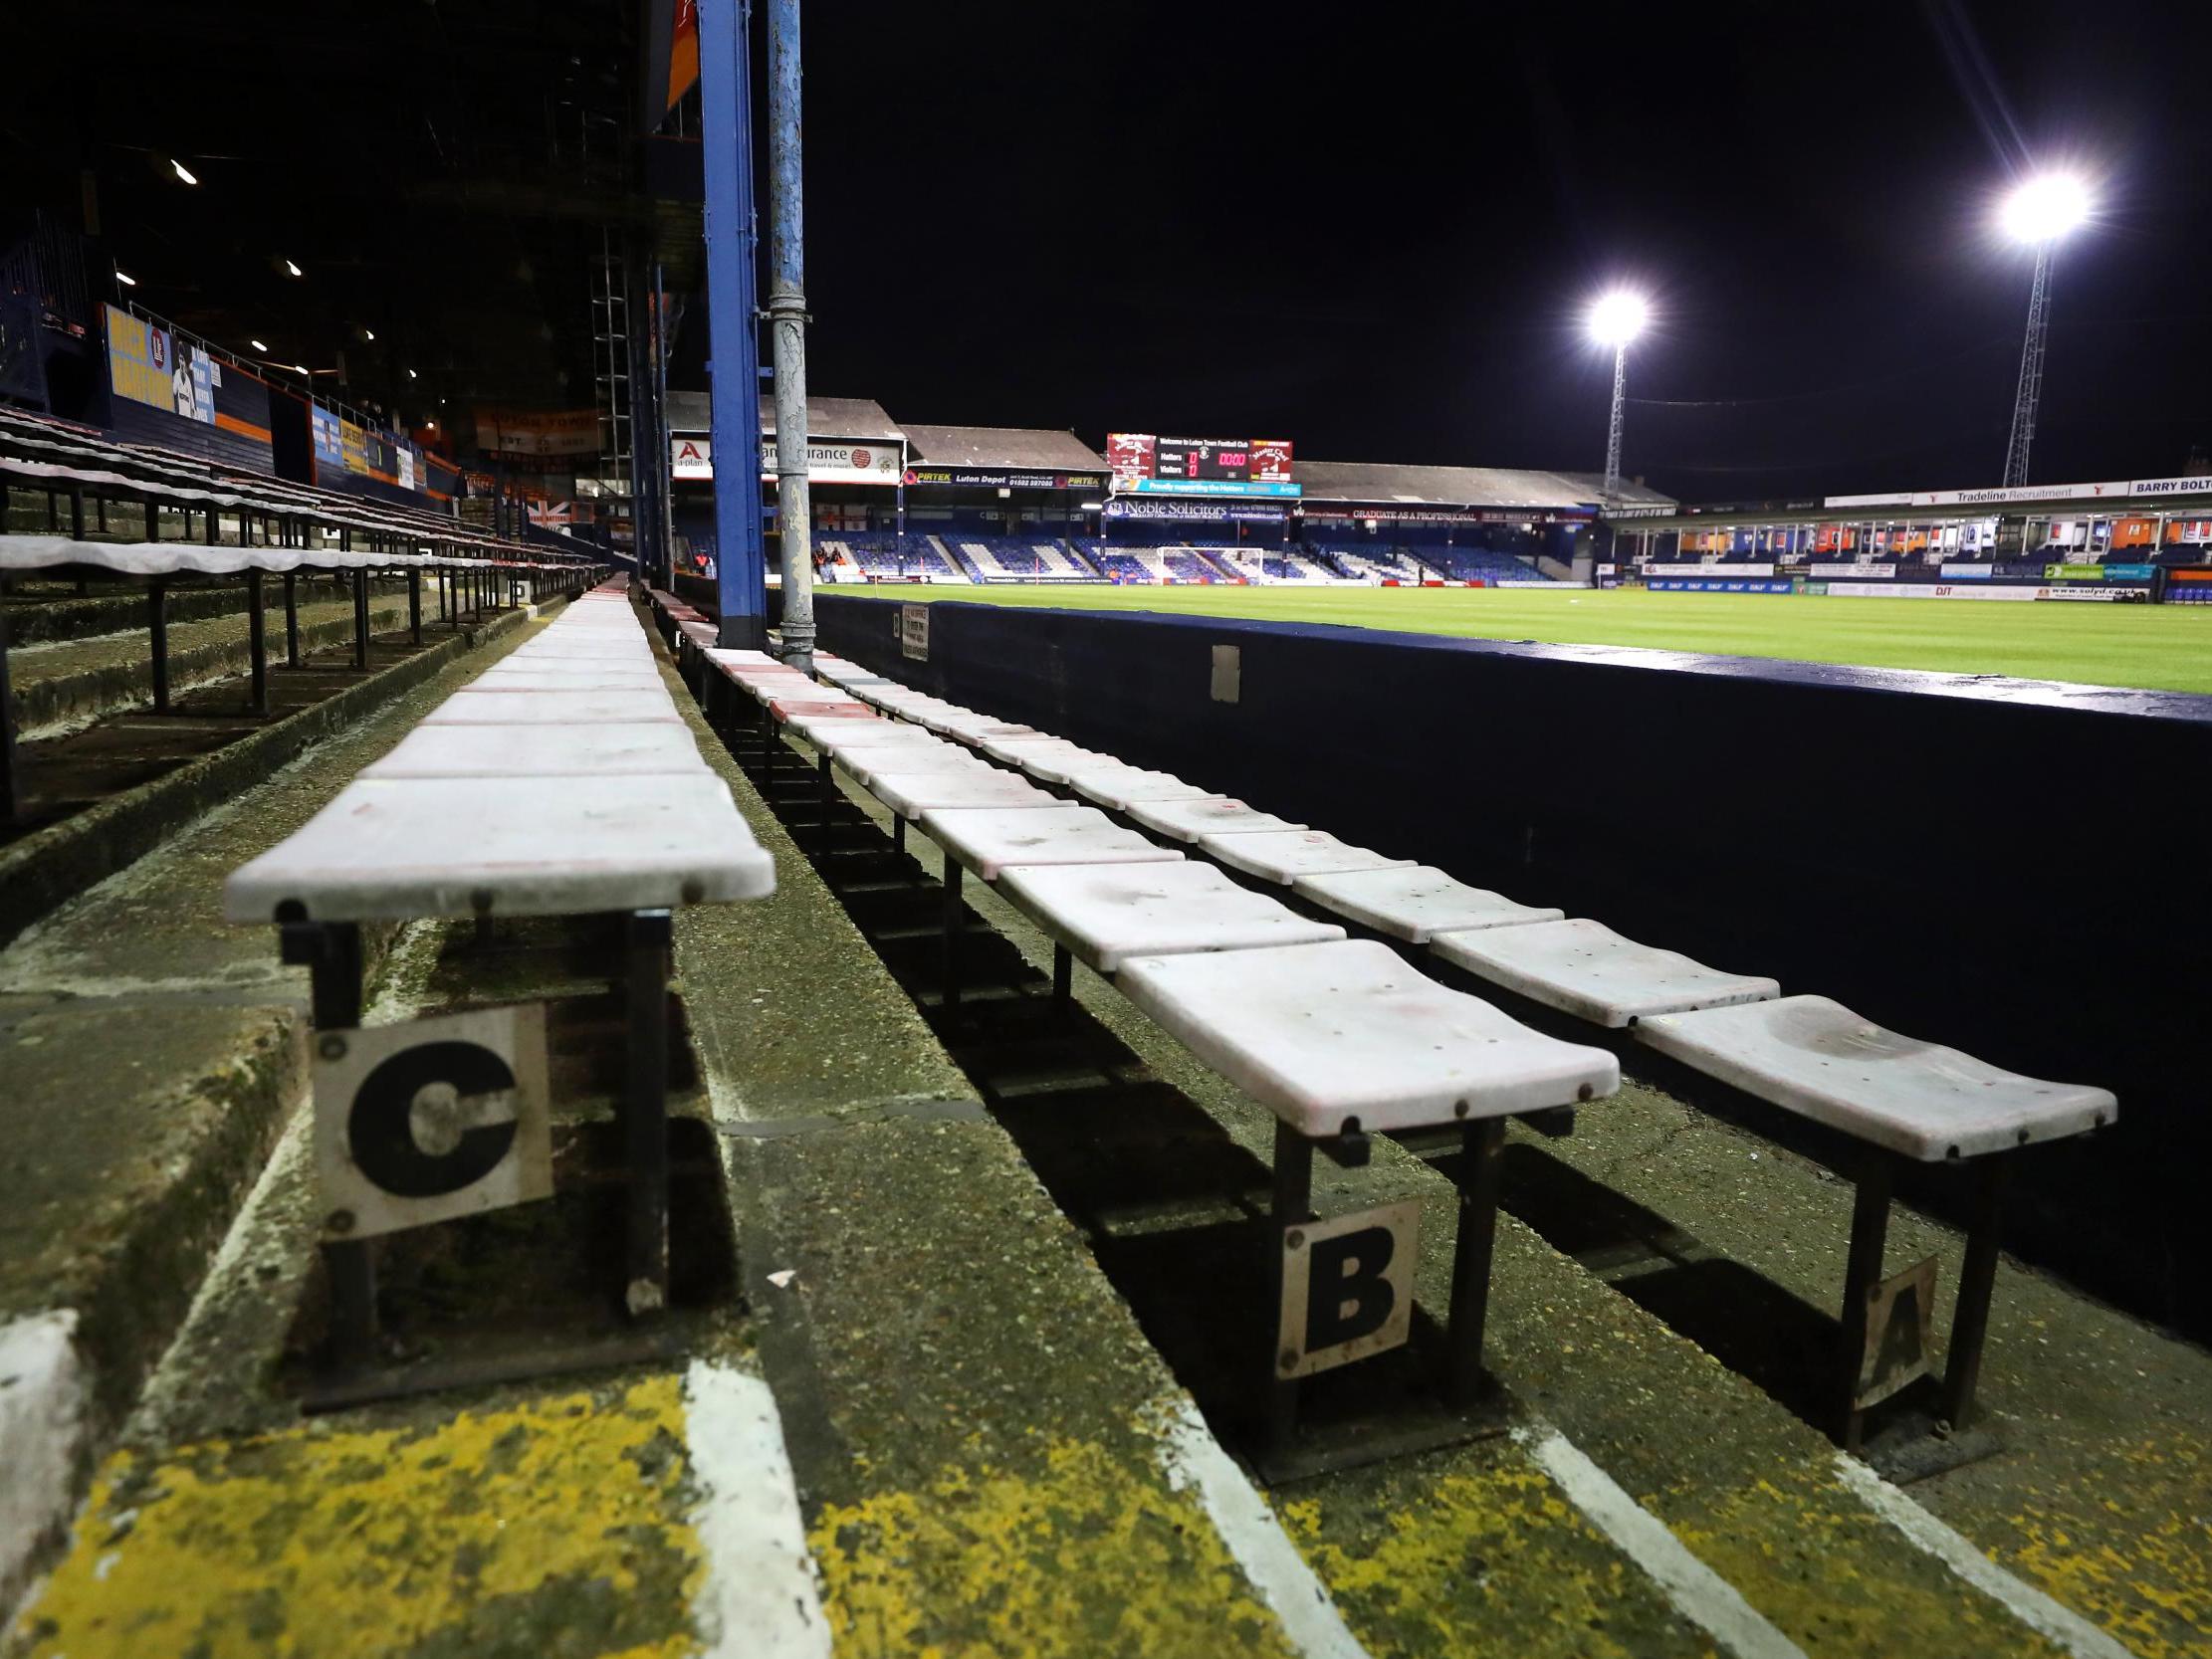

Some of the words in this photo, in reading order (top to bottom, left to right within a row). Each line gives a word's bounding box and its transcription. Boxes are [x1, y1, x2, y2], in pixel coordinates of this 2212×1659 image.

[678, 459, 703, 468] a-plan
[1218, 453, 1245, 466] 00:00
[1160, 465, 1182, 474] Visitors
[917, 472, 951, 482] PIRTEK
[981, 476, 1005, 486] Depot
[1067, 477, 1100, 486] PIRTEK
[1149, 482, 1173, 491] Proudly
[2136, 482, 2177, 493] BARRY
[2180, 480, 2212, 491] BOLT
[1957, 491, 2006, 502] Tradeline
[2008, 489, 2073, 500] Recruitment
[1125, 500, 1166, 514] Noble
[1169, 502, 1226, 516] Solicitors
[1354, 510, 1397, 519] GRADUATE
[1399, 511, 1409, 519] AS
[1417, 512, 1476, 521] PROFESSIONAL
[347, 1040, 519, 1199] C
[1304, 1226, 1395, 1354] B
[1871, 1285, 1922, 1388] A
